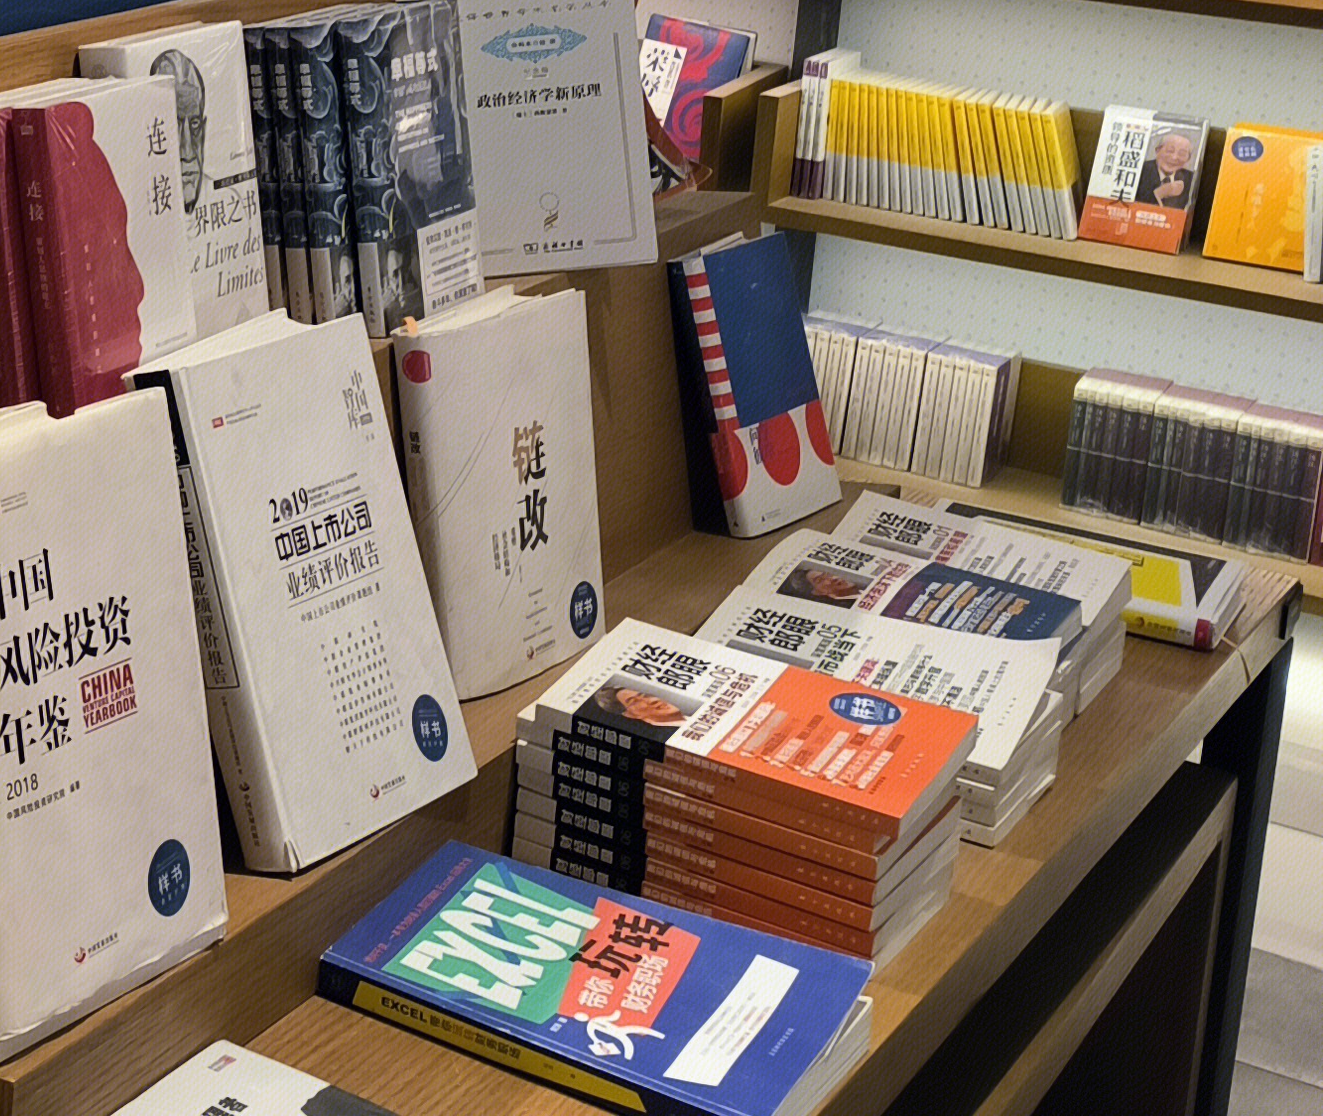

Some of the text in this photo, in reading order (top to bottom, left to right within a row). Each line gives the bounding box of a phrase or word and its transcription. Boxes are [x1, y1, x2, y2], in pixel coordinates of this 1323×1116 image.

[476, 82, 603, 110] 政治经济学新原理
[145, 115, 173, 218] 连接
[194, 189, 257, 239] 界限之书
[205, 227, 261, 269] Livre des
[216, 264, 264, 299] Limites
[511, 420, 550, 552] 链改
[274, 499, 374, 563] 中国上市公司
[286, 538, 382, 601] 业绩评价报告
[735, 607, 781, 643] 财经
[768, 613, 820, 654] 郎眼
[621, 643, 677, 681] 财经
[656, 652, 737, 692] 郎眼 06
[79, 664, 135, 705] CHINA
[82, 693, 139, 729] YEARBOOK
[5, 772, 39, 802] 2018
[396, 877, 602, 1011] EXCEL
[568, 913, 674, 980] 玩转
[578, 978, 616, 1011] 带你
[619, 953, 670, 1015] 财务职场
[380, 996, 428, 1023] EXCEL
